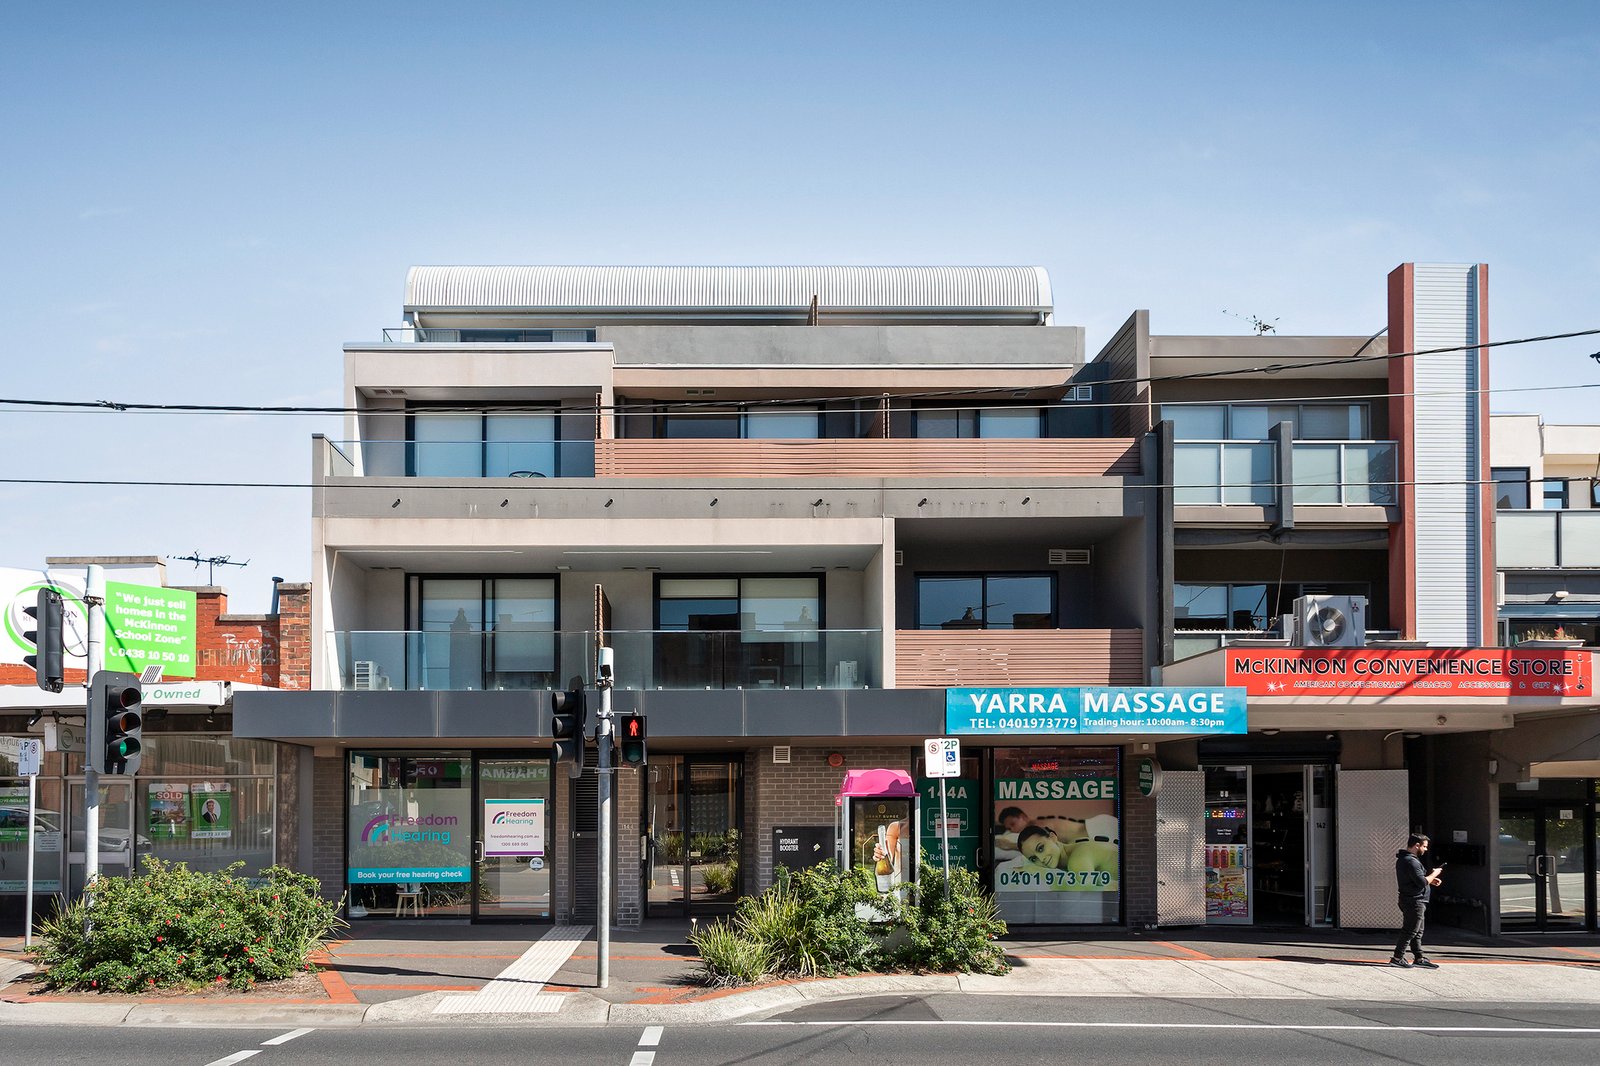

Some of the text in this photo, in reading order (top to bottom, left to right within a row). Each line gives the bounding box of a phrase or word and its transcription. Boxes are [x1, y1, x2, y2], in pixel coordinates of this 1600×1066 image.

[143, 596, 165, 607] just
[168, 600, 186, 610] sell
[115, 604, 187, 621] homes in the
[124, 617, 178, 632] McKinnon
[114, 629, 152, 642] School
[118, 647, 190, 663] 0438 10 50 10
[1353, 657, 1502, 675] CONVENIENCE
[1509, 658, 1573, 676] STORE
[1293, 680, 1551, 689] AMERICAN CONFECTIONARY TOBACCO ACCESSORIES & GIFT
[153, 688, 201, 699] Owned
[969, 692, 1225, 714] YARRA MASSAGE
[969, 717, 1077, 729] TEL: 0401973779
[1084, 717, 1118, 727] Trading
[1120, 717, 1145, 726] hour:
[1190, 718, 1225, 728] 8:30pm
[944, 740, 958, 750] 2P
[156, 791, 183, 799] SOLD
[999, 780, 1114, 799] MASSAGE
[391, 814, 458, 826] Freedom
[391, 829, 451, 845] Hearing
[929, 853, 966, 861] Rebance
[357, 871, 377, 879] Book
[411, 871, 440, 879] hearing
[440, 870, 463, 878] check
